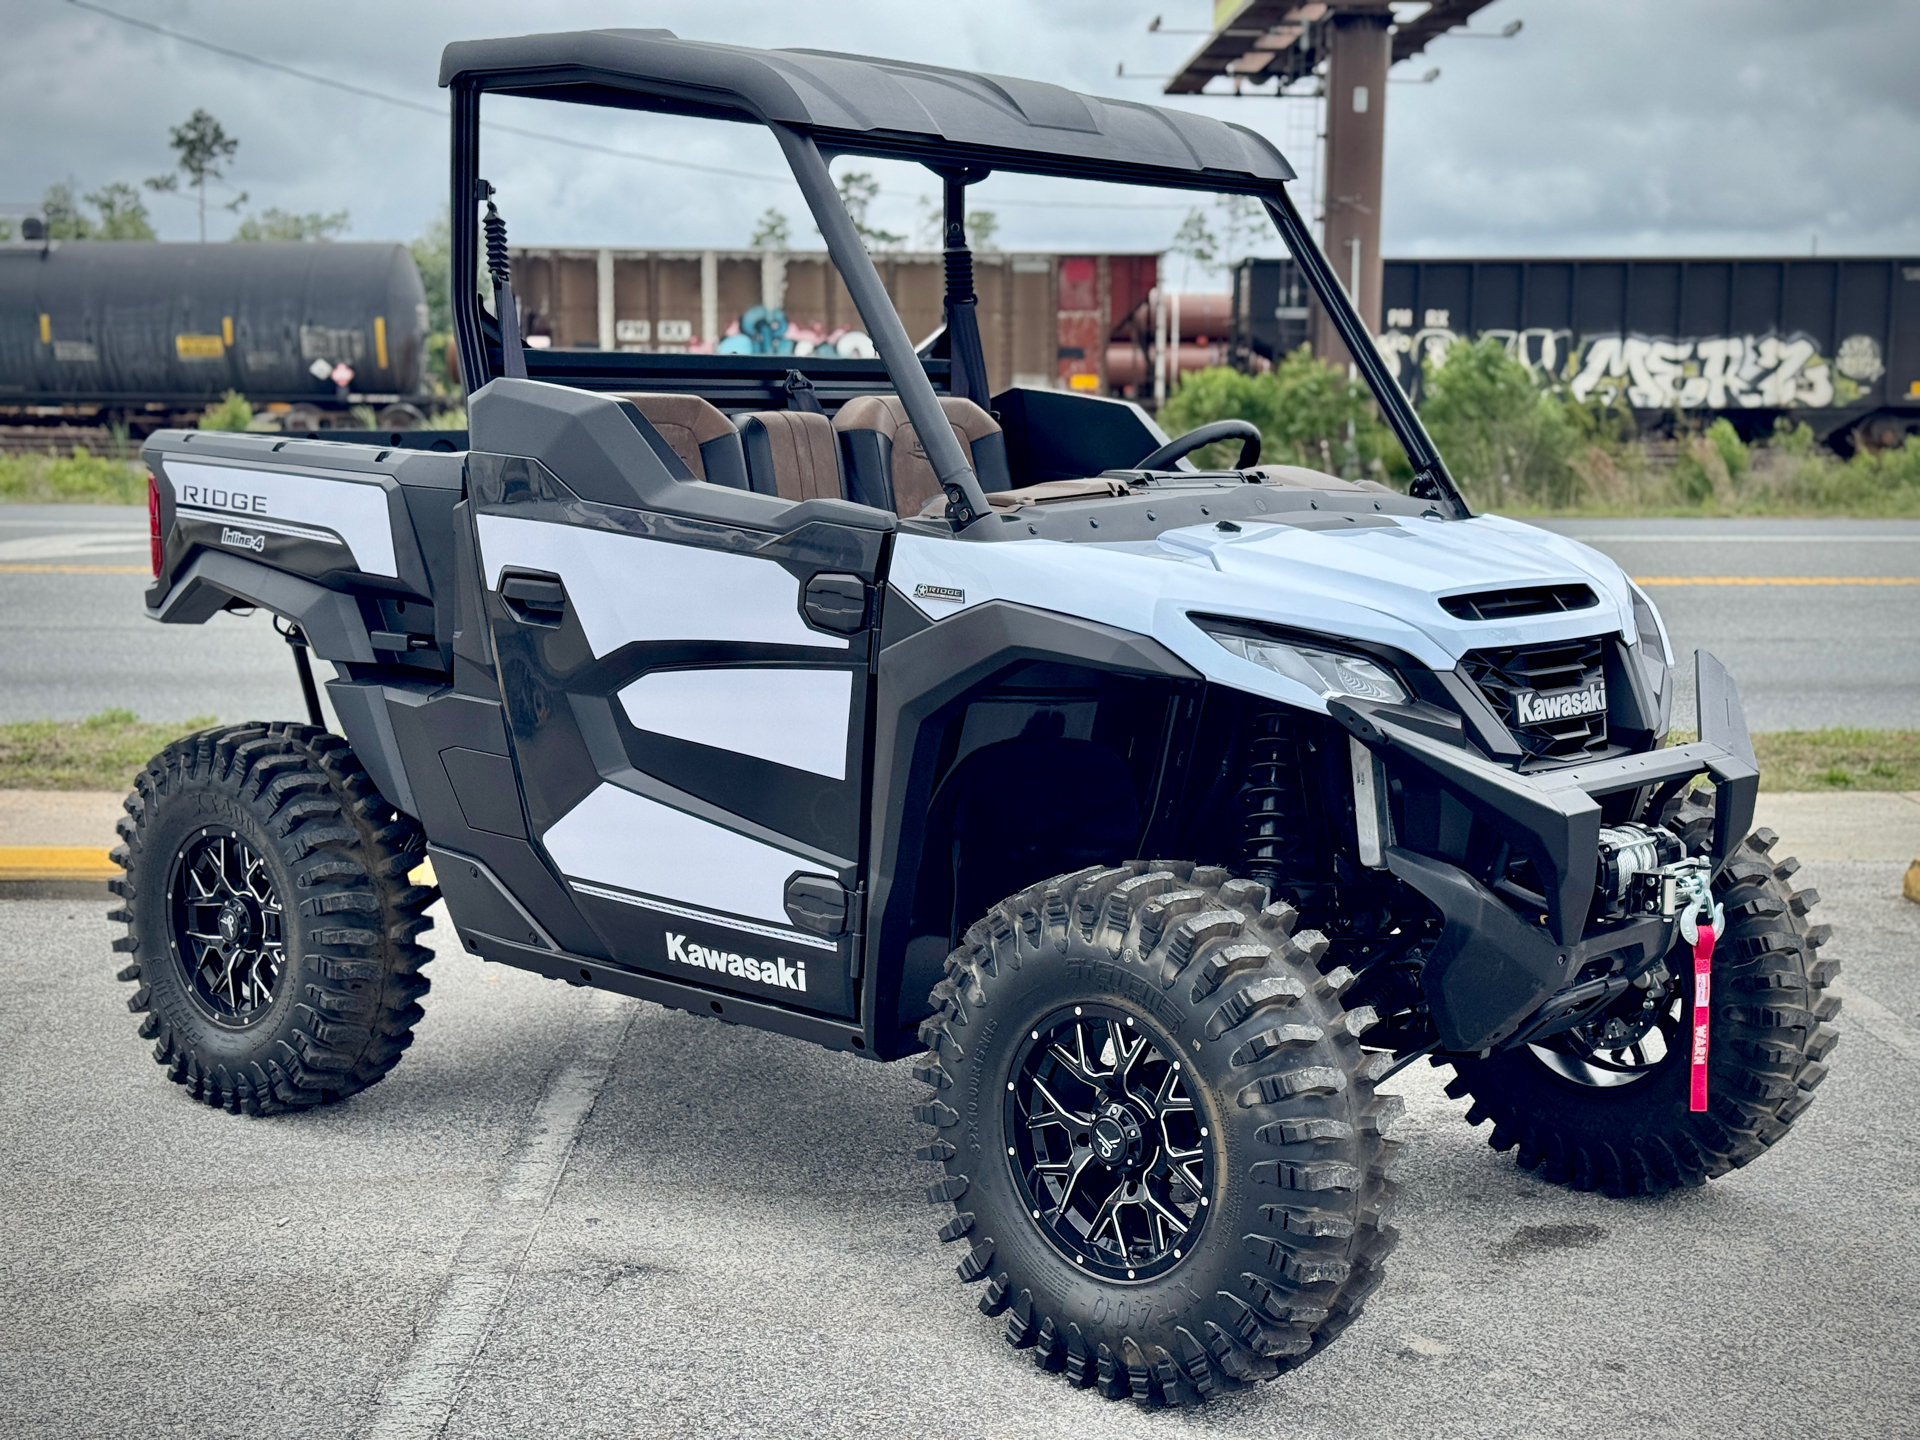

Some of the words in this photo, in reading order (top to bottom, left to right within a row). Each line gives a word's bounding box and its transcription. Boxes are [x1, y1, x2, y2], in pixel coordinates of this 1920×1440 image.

[183, 485, 268, 514] RIDGE
[221, 527, 265, 552] Inline-4
[928, 586, 962, 596] RIDGE
[1517, 682, 1607, 724] Kawasaki
[665, 931, 807, 992] Kawasaki
[1693, 1023, 1708, 1065] WARN
